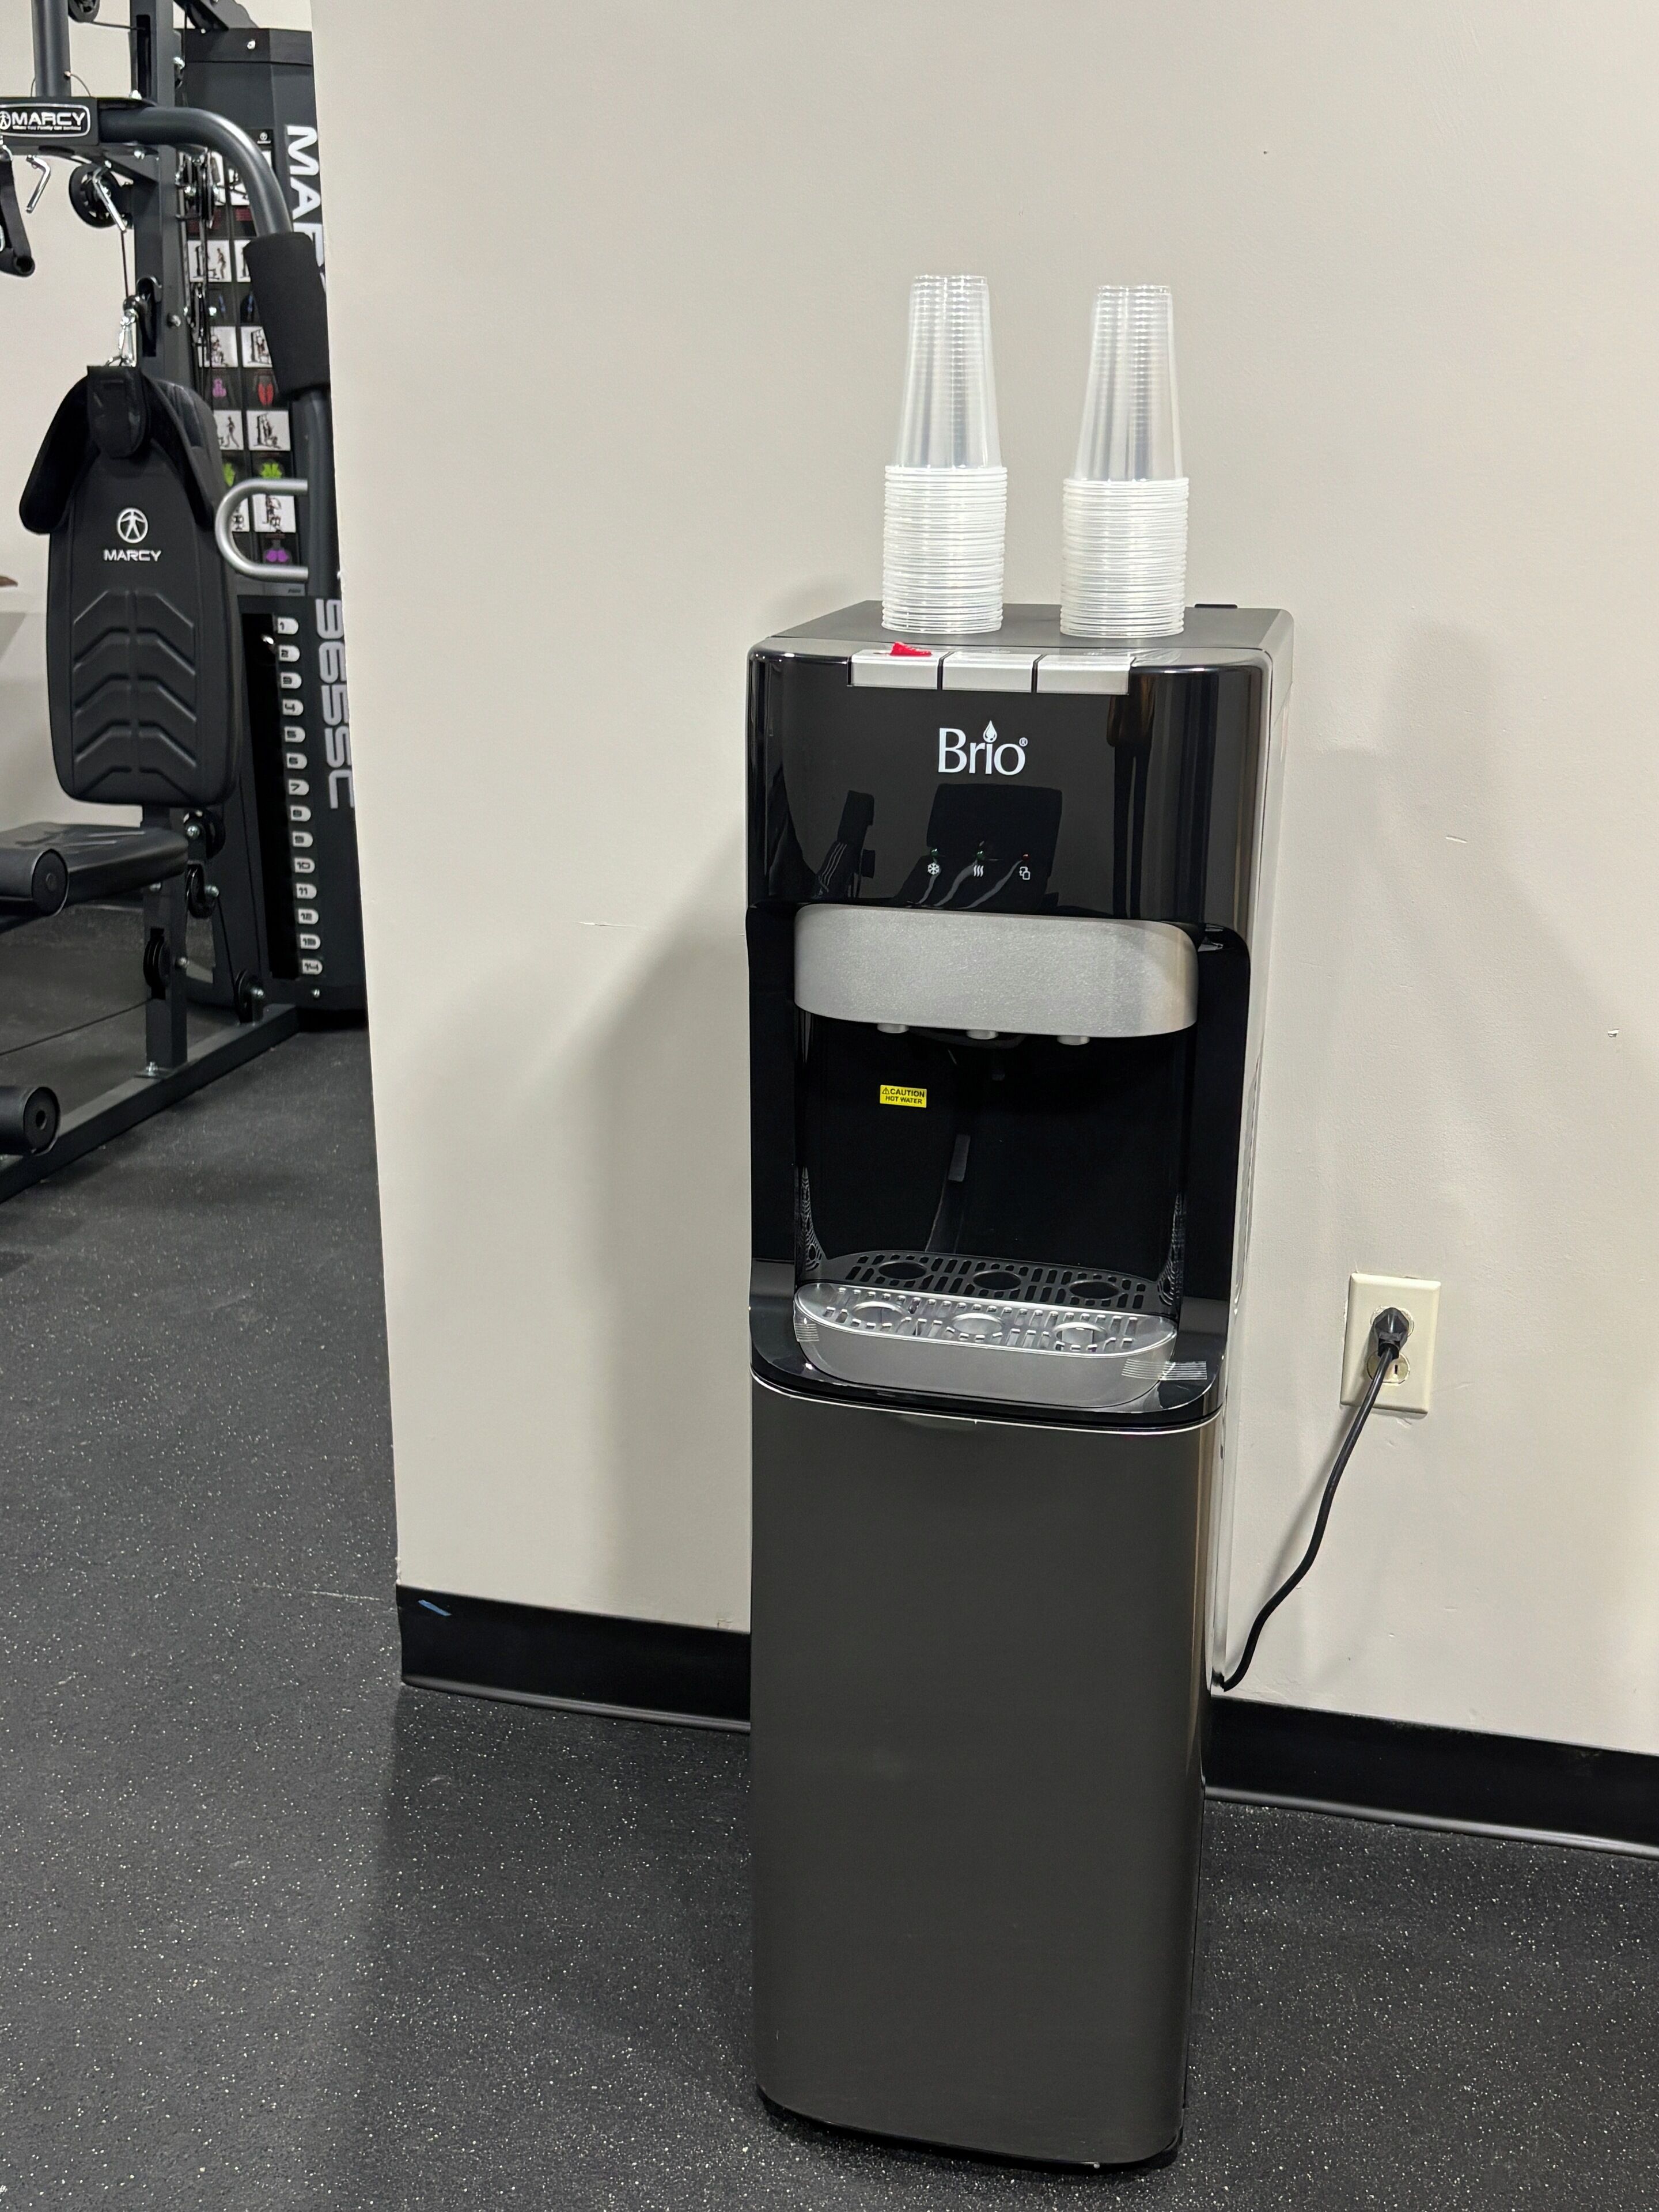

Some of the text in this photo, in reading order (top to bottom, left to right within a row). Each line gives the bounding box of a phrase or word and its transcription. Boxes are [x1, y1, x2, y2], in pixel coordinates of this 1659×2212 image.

[12, 112, 86, 126] MARCY
[104, 549, 161, 562] MARCY
[290, 783, 300, 791] 7
[297, 861, 310, 869] 10
[298, 887, 308, 895] 11
[890, 1088, 925, 1098] CAUTION
